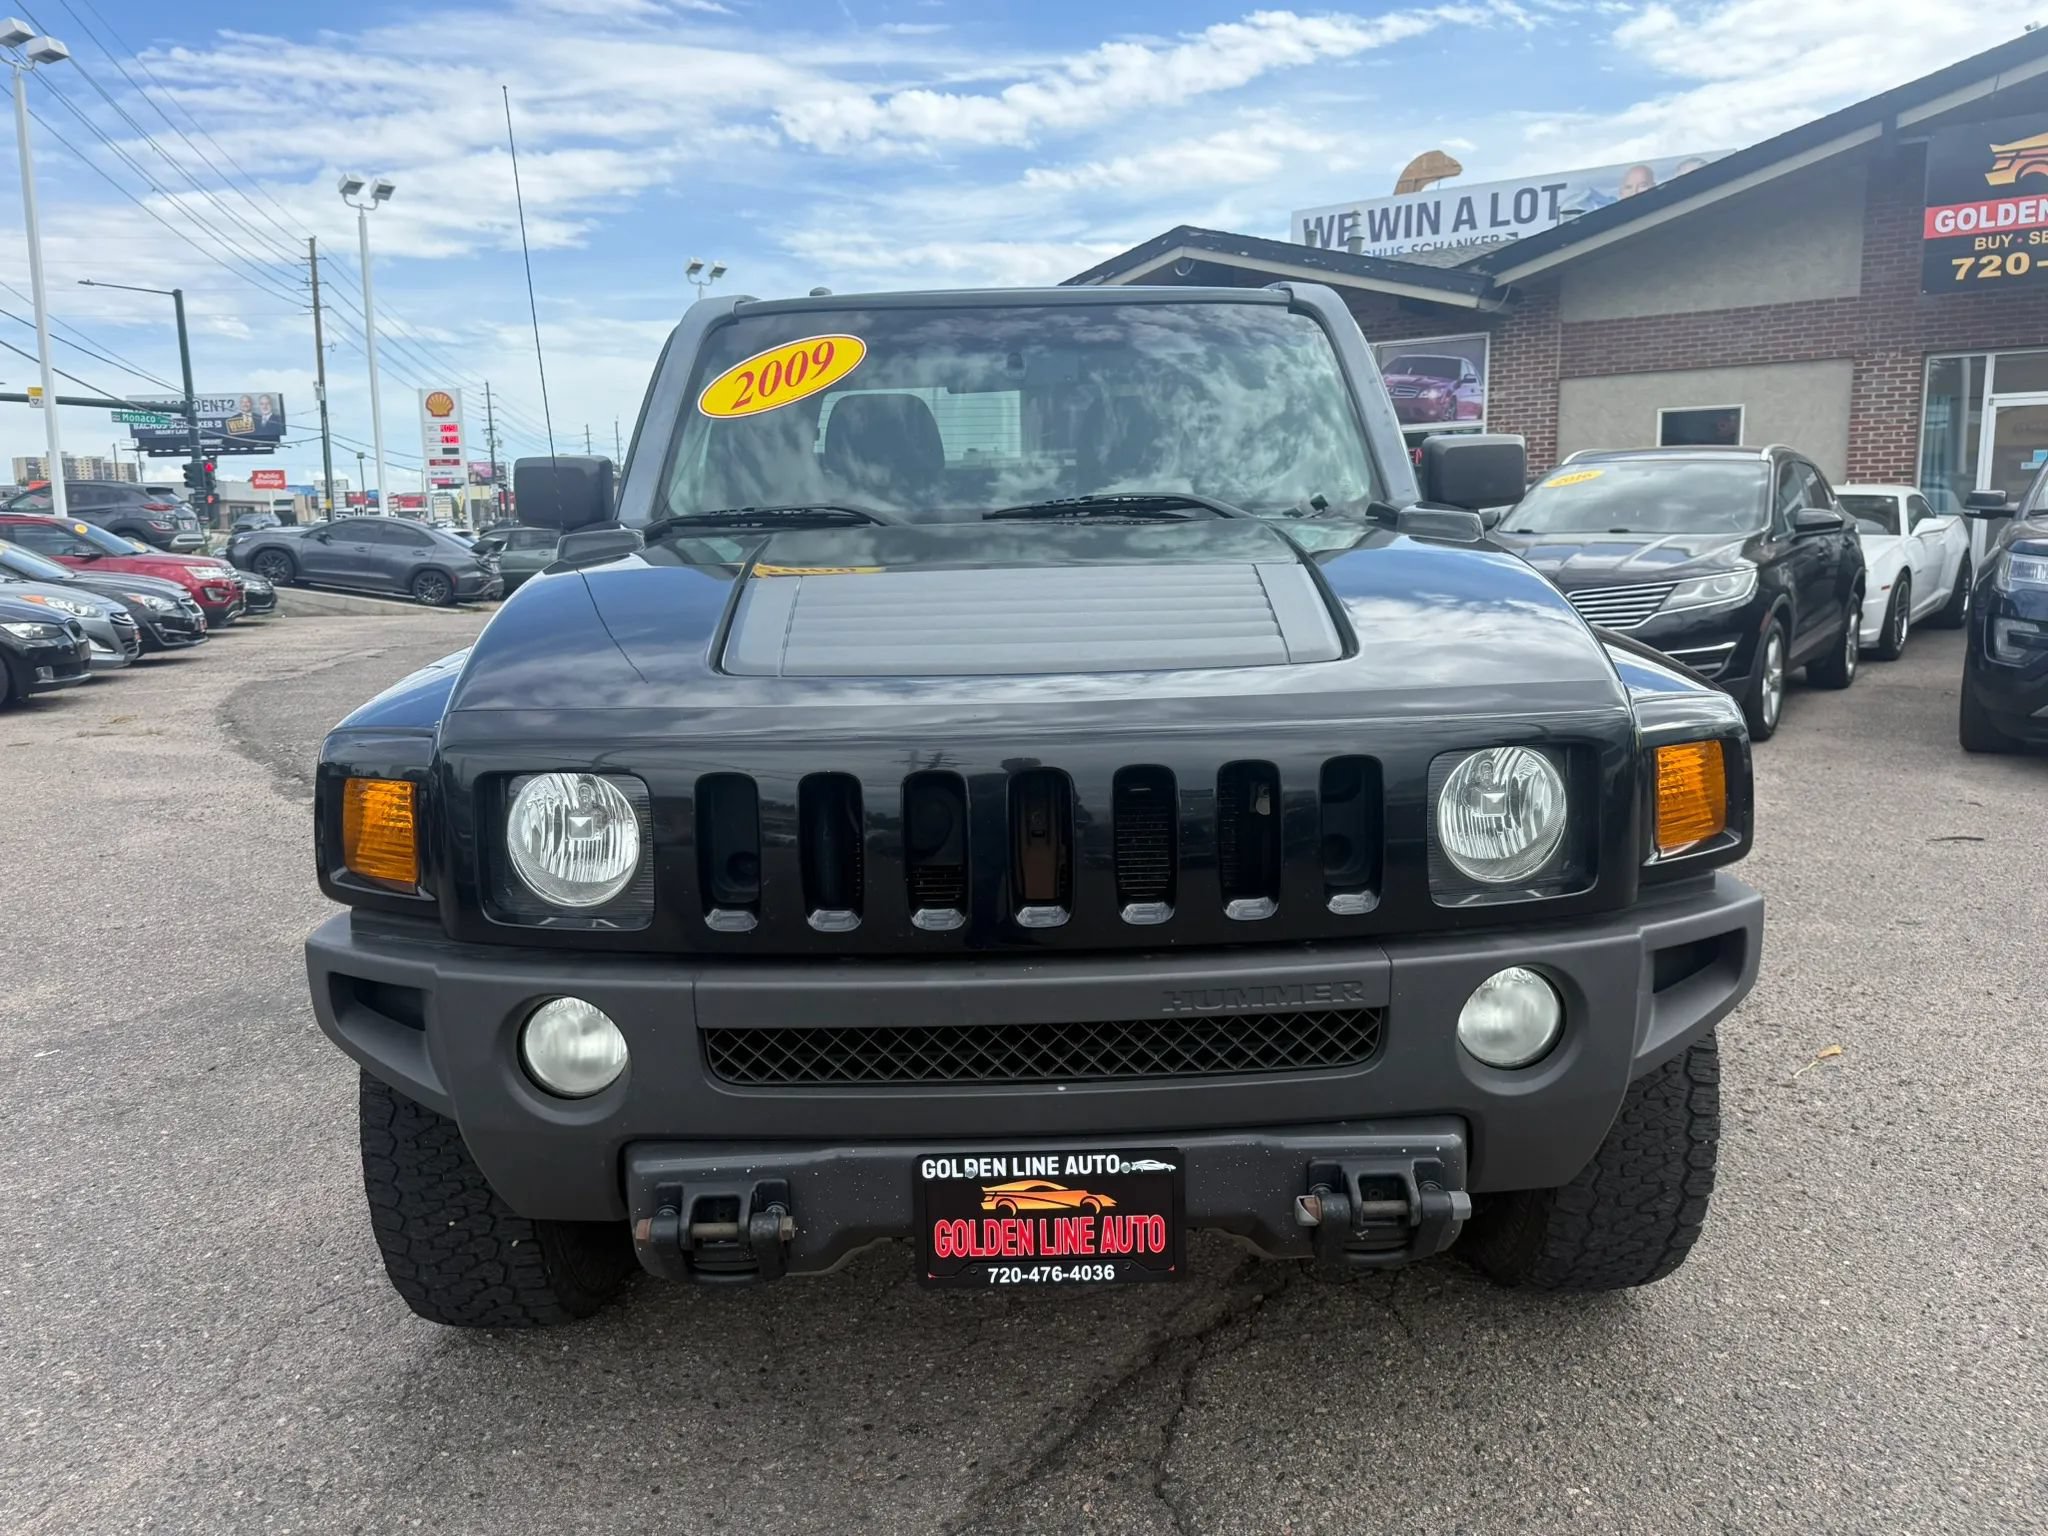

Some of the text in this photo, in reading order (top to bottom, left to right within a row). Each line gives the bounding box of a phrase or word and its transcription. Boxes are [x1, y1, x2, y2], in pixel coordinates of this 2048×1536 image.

[1303, 183, 1567, 249] WE WIN A LOT
[1974, 234, 2013, 250] BUY
[731, 341, 835, 410] 2009
[122, 412, 156, 423] Monaco
[1162, 980, 1364, 1012] HUMMER
[921, 1154, 1120, 1179] GOLDEN LINE AUTO
[934, 1214, 1166, 1258] GOLDEN LINE AUTO
[987, 1264, 1115, 1283] 720-476-4036
